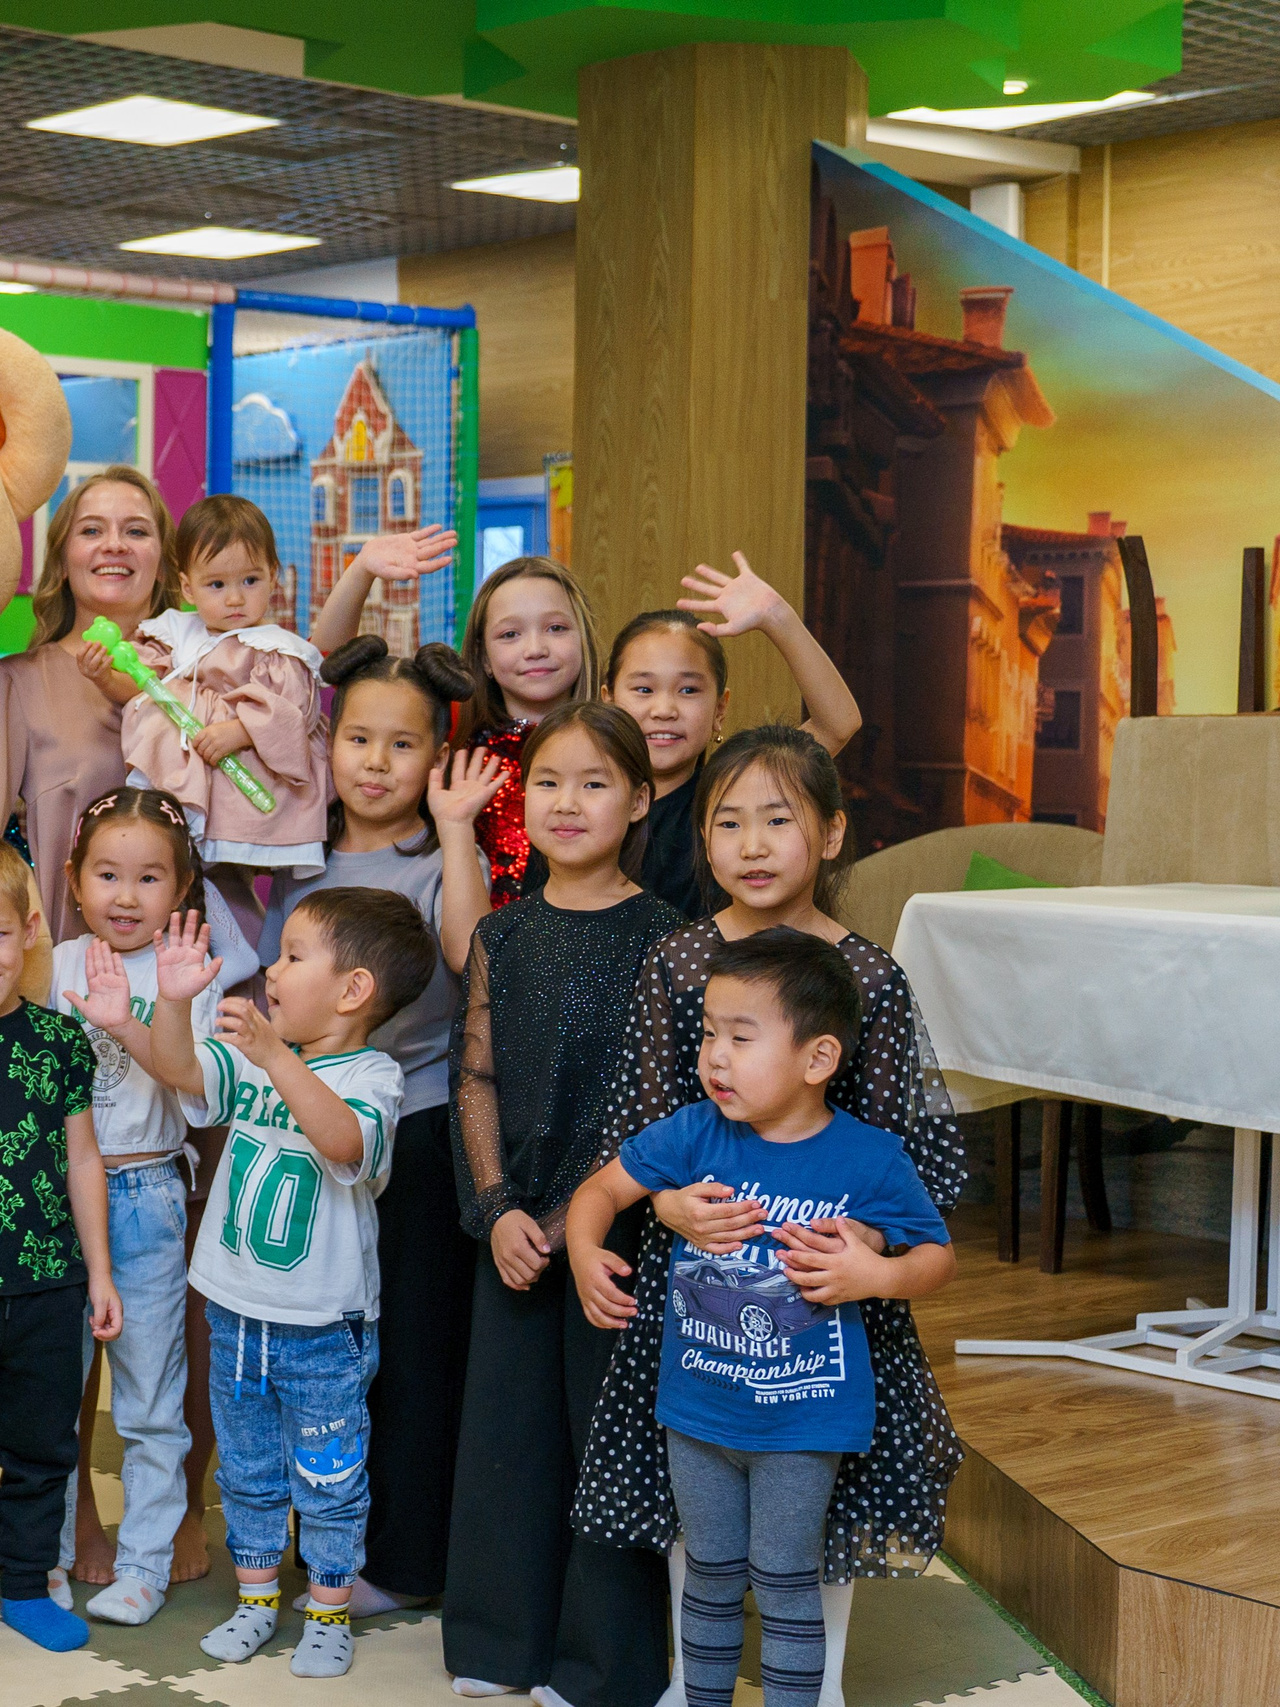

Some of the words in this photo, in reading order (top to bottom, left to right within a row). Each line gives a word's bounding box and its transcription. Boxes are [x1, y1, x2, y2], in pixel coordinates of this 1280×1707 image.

[220, 1129, 323, 1272] 10
[681, 1348, 826, 1382] Championship
[754, 1395, 778, 1404] NEW
[782, 1390, 808, 1402] YORK
[811, 1388, 835, 1398] CITY
[321, 1425, 328, 1434] A
[329, 1418, 345, 1431] BITE
